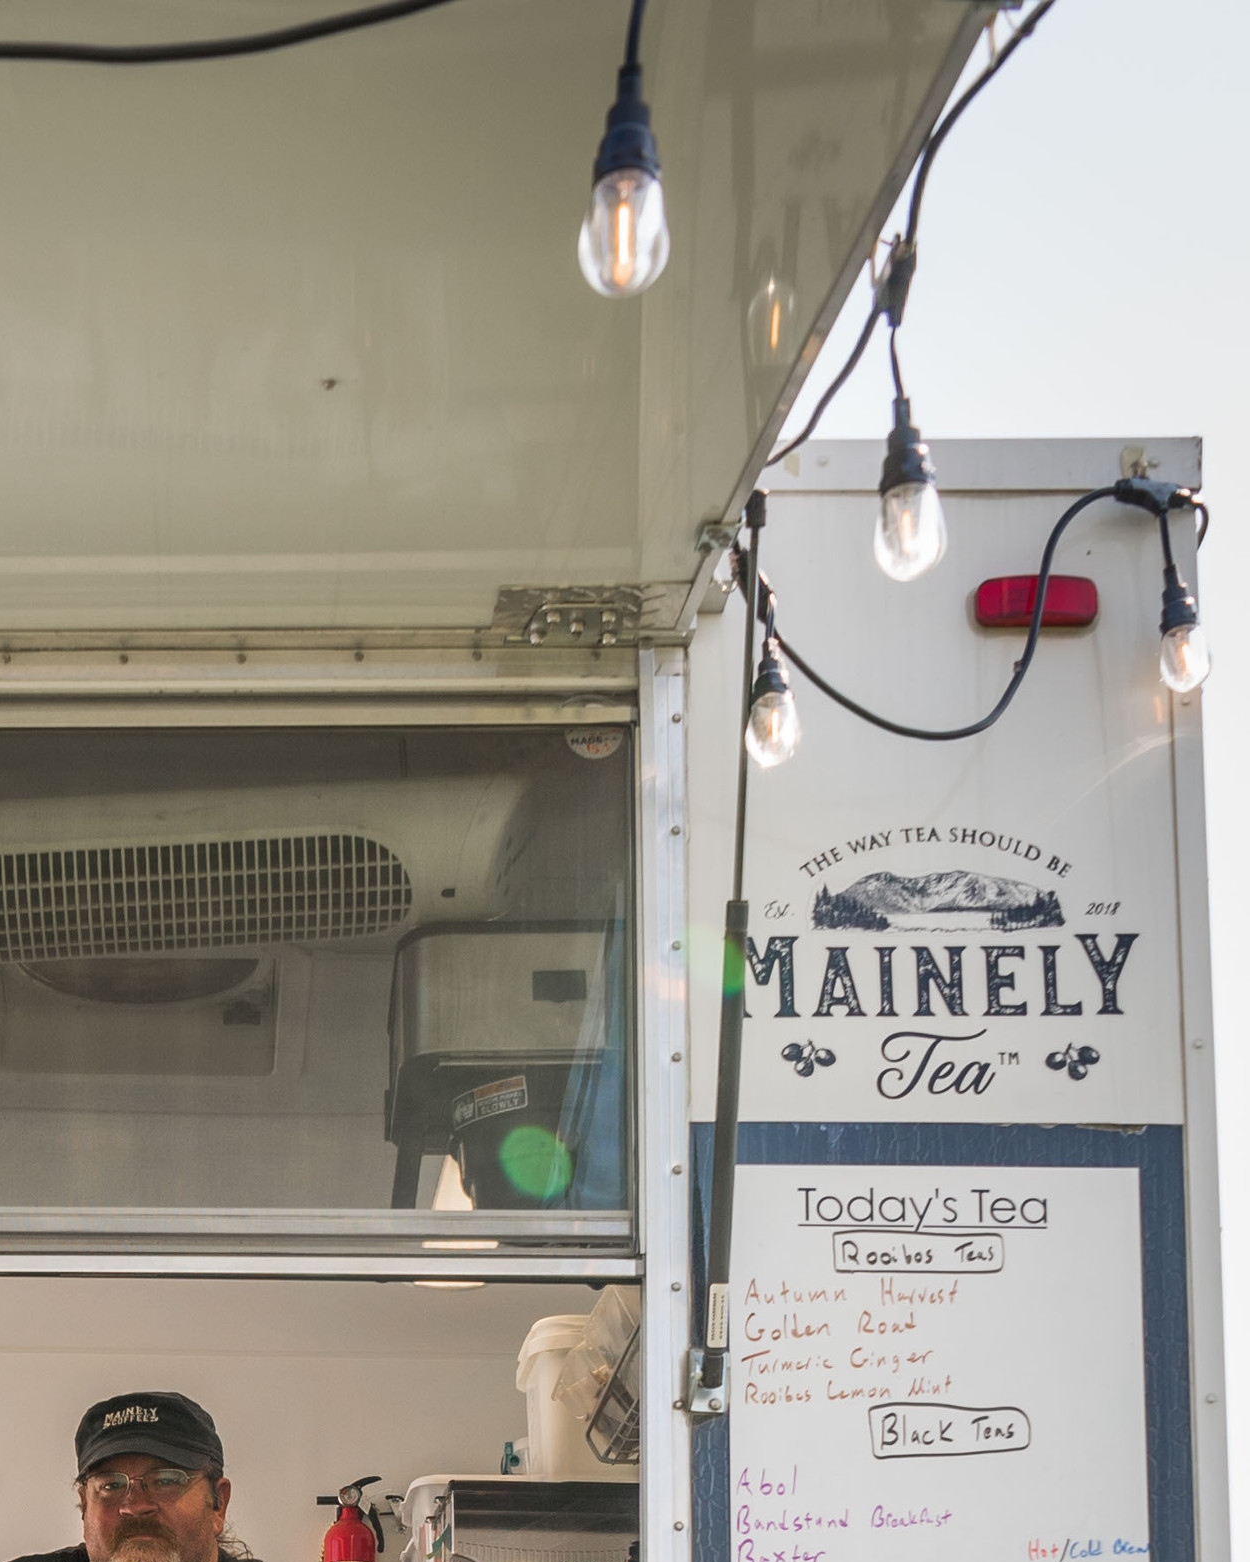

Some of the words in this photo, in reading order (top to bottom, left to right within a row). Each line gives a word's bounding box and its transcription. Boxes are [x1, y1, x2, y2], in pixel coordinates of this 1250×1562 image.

[799, 847, 844, 878] THE
[847, 830, 893, 855] WAY
[899, 827, 941, 844] TEA
[949, 827, 1041, 862] SHOULD
[1046, 855, 1073, 879] BE
[1085, 901, 1121, 916] 2018
[743, 933, 1140, 1018] MAINELY
[877, 1028, 995, 1099] Tea
[798, 1187, 958, 1231] Today's
[971, 1189, 1047, 1224] Tea
[841, 1240, 933, 1265] Rooibos
[954, 1241, 995, 1263] Teas
[744, 1279, 848, 1306] Autumn
[880, 1277, 959, 1306] Harvest
[744, 1312, 830, 1342] Golden
[858, 1311, 917, 1335] Road
[741, 1350, 834, 1376] Turmeric
[850, 1348, 934, 1374] Ginger
[744, 1382, 812, 1405] Rooibos
[827, 1380, 890, 1400] Lemon
[908, 1375, 952, 1398] Mint
[104, 1406, 157, 1424] MAINELY
[880, 1412, 954, 1451] Black
[971, 1415, 1015, 1441] Teas
[736, 1465, 797, 1496] Abol
[736, 1504, 849, 1534] Bandstand
[870, 1505, 953, 1528] Breakfast
